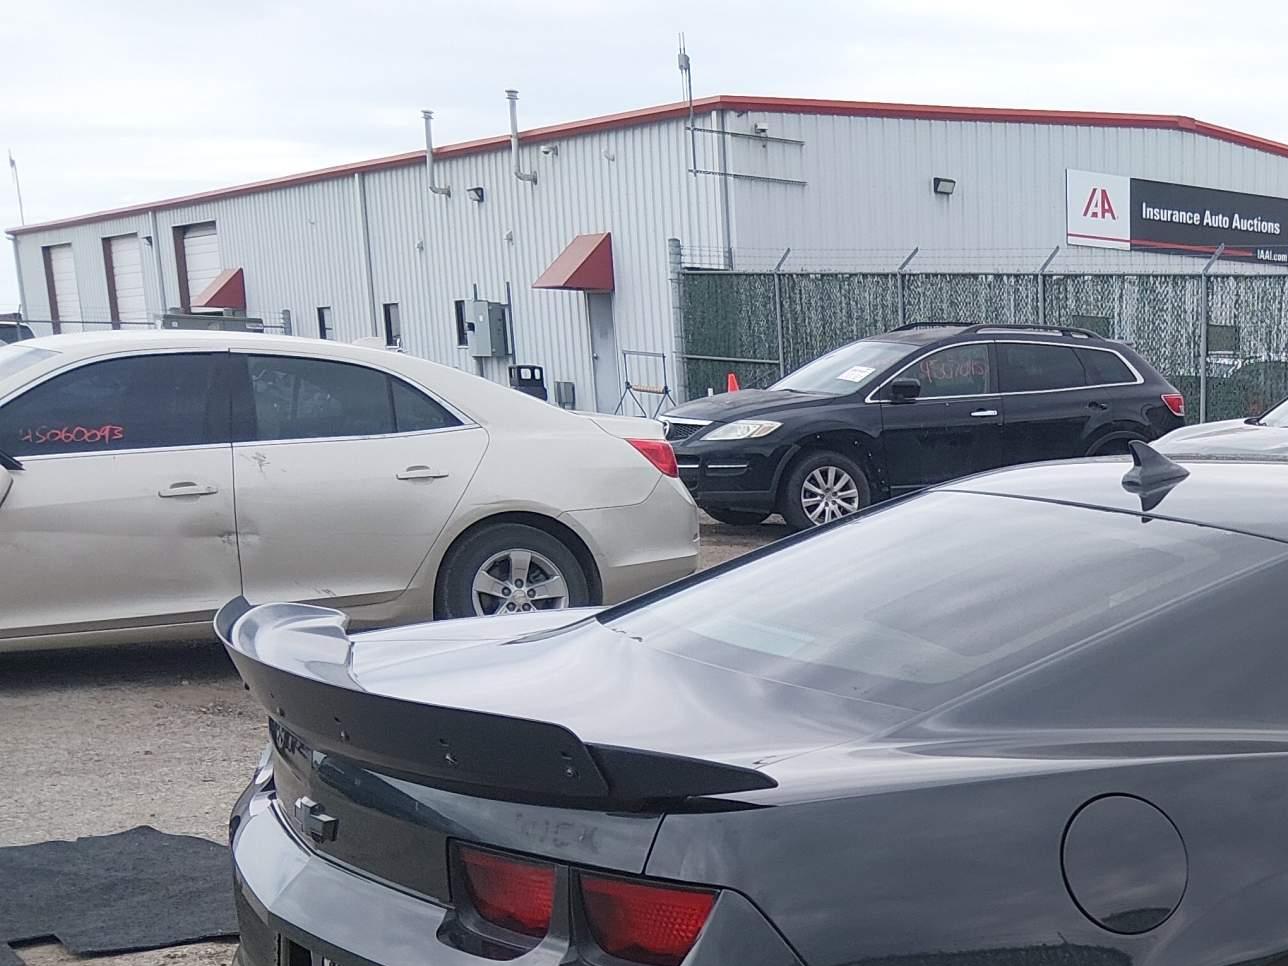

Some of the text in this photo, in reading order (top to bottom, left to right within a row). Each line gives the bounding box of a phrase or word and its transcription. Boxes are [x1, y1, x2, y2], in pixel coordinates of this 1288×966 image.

[1142, 202, 1281, 235] Insurance Auto Auctions
[1257, 248, 1288, 262] IAAI.com
